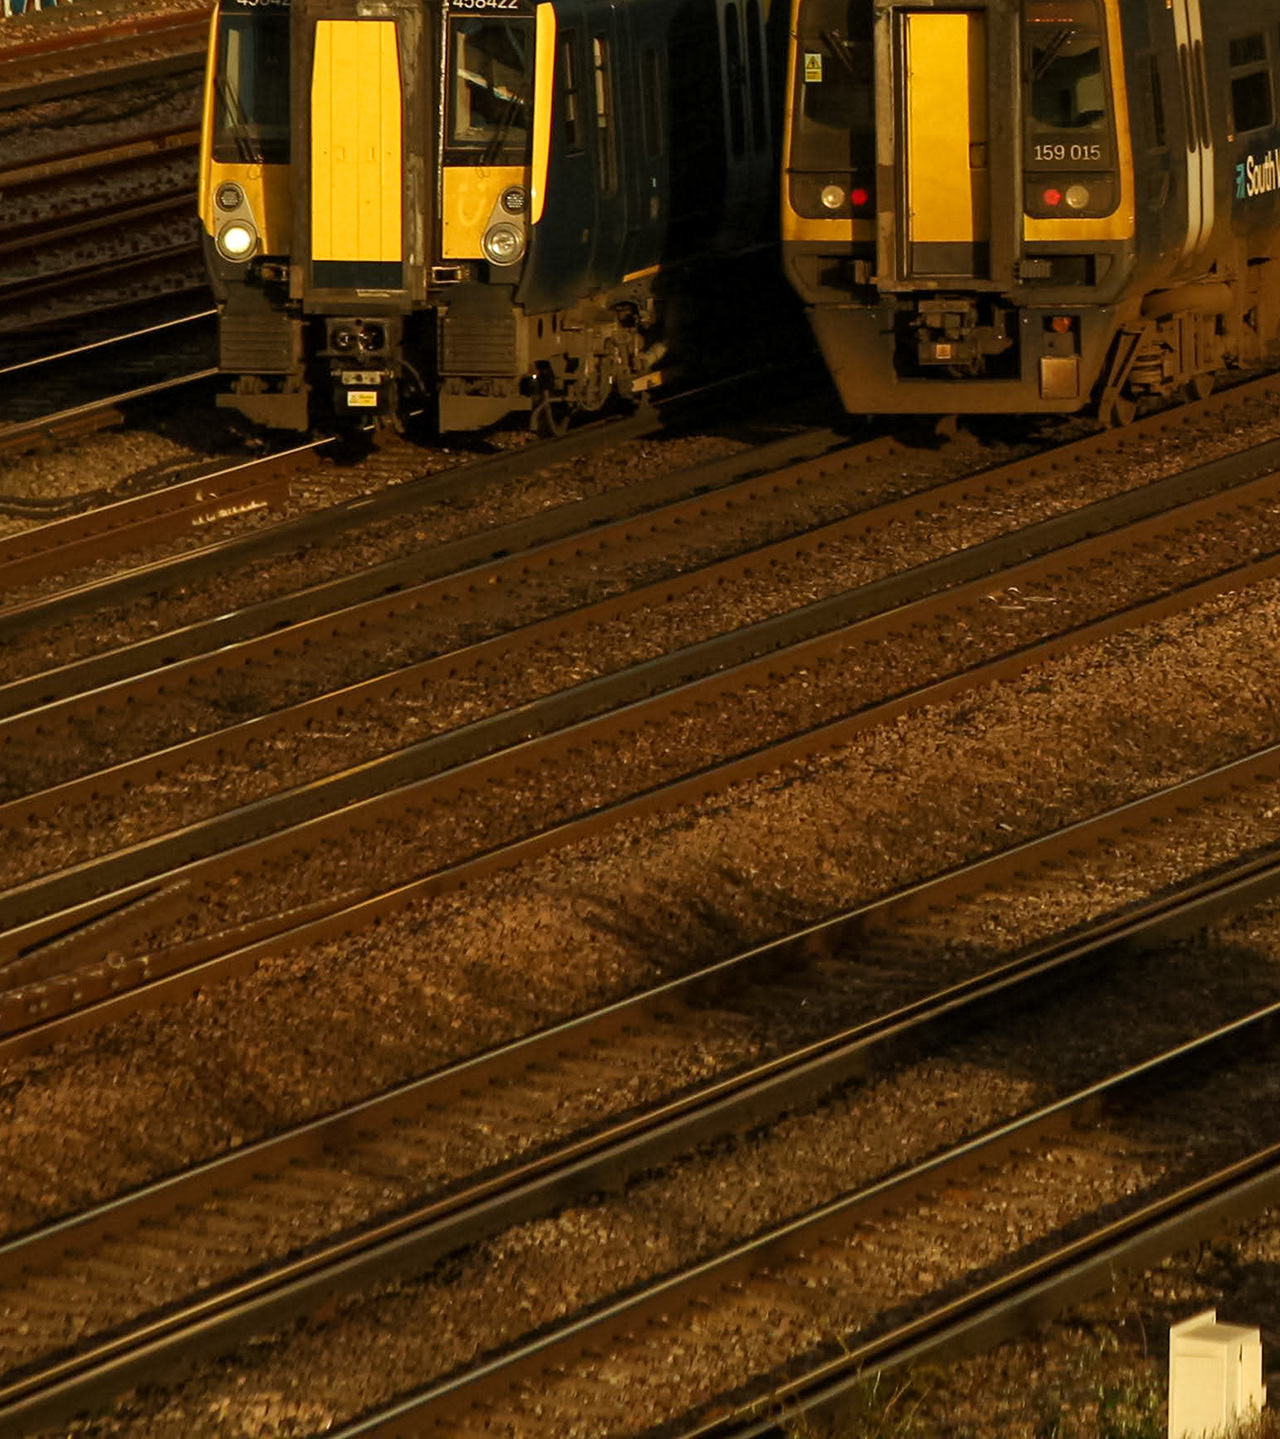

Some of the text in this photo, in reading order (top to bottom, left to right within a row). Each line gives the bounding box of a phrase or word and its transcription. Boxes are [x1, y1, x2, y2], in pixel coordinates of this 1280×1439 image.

[1034, 144, 1101, 161] 159 015
[1246, 150, 1276, 197] South
